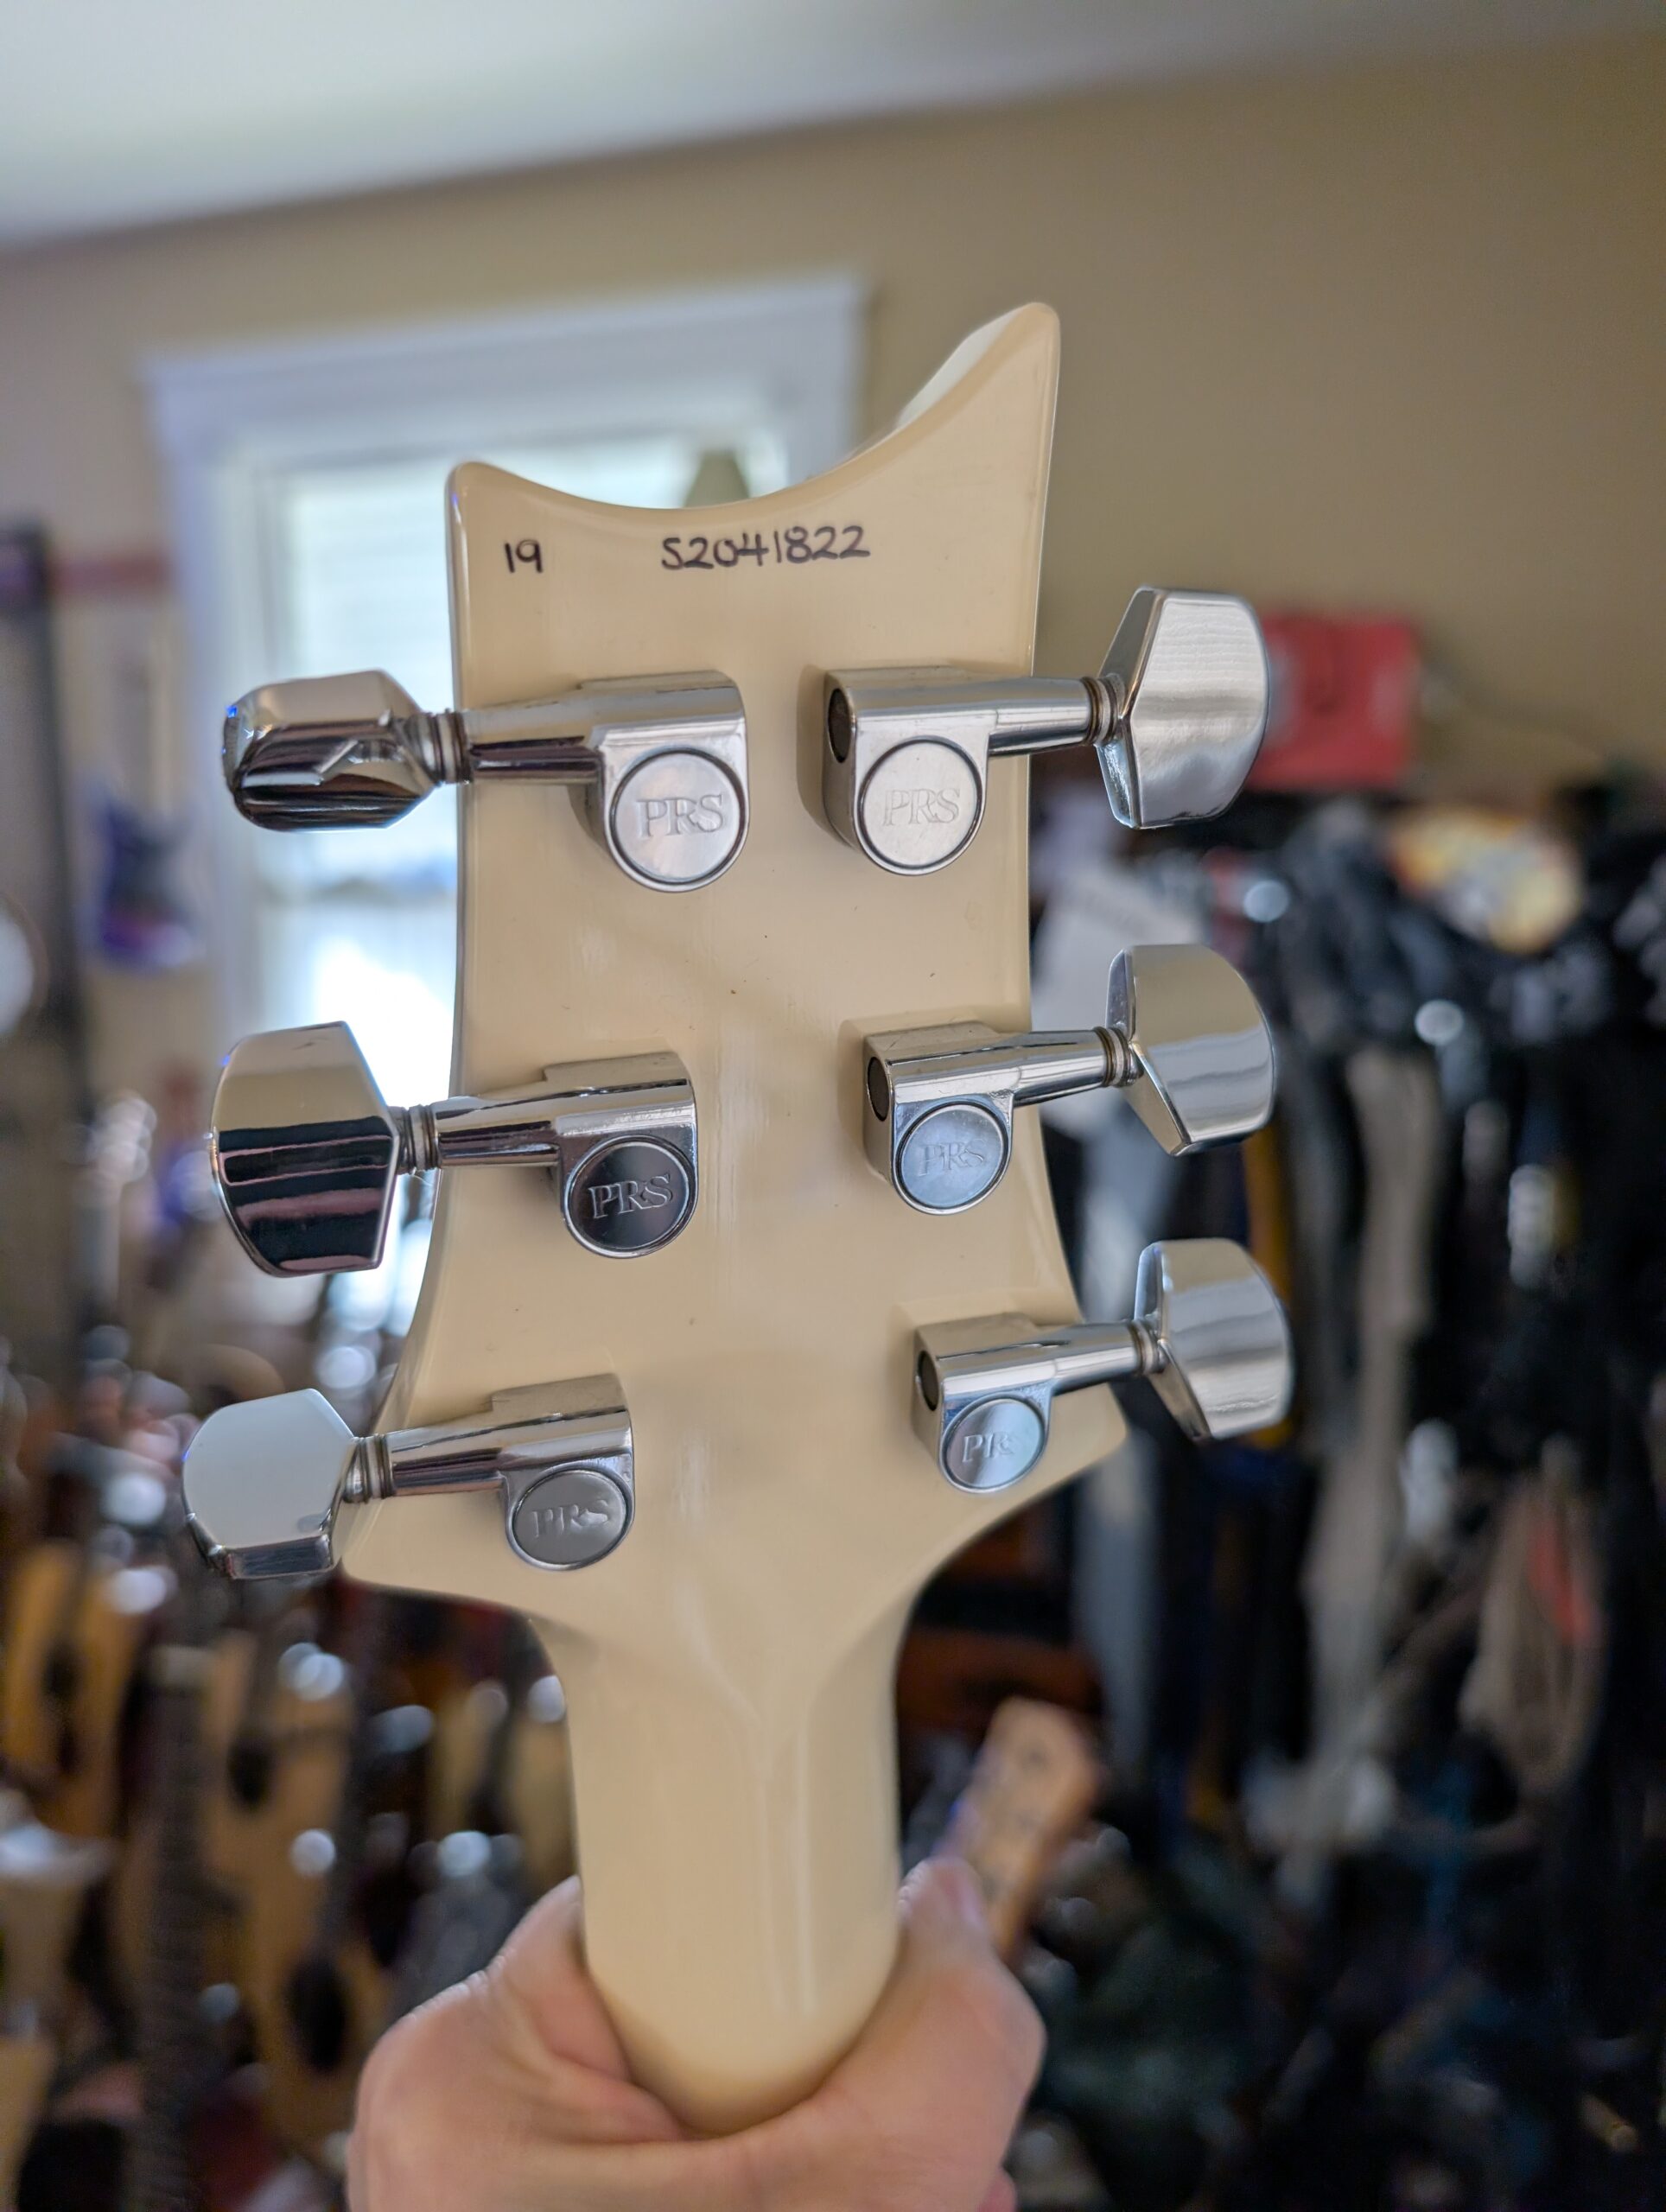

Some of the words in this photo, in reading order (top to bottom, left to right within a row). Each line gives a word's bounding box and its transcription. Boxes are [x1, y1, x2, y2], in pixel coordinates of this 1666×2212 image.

[504, 539, 544, 574] 19
[660, 524, 871, 570] S2041822
[635, 793, 726, 838] PRS
[882, 787, 962, 828] PRS
[916, 1138, 988, 1177] PRS
[587, 1173, 675, 1219] PRS
